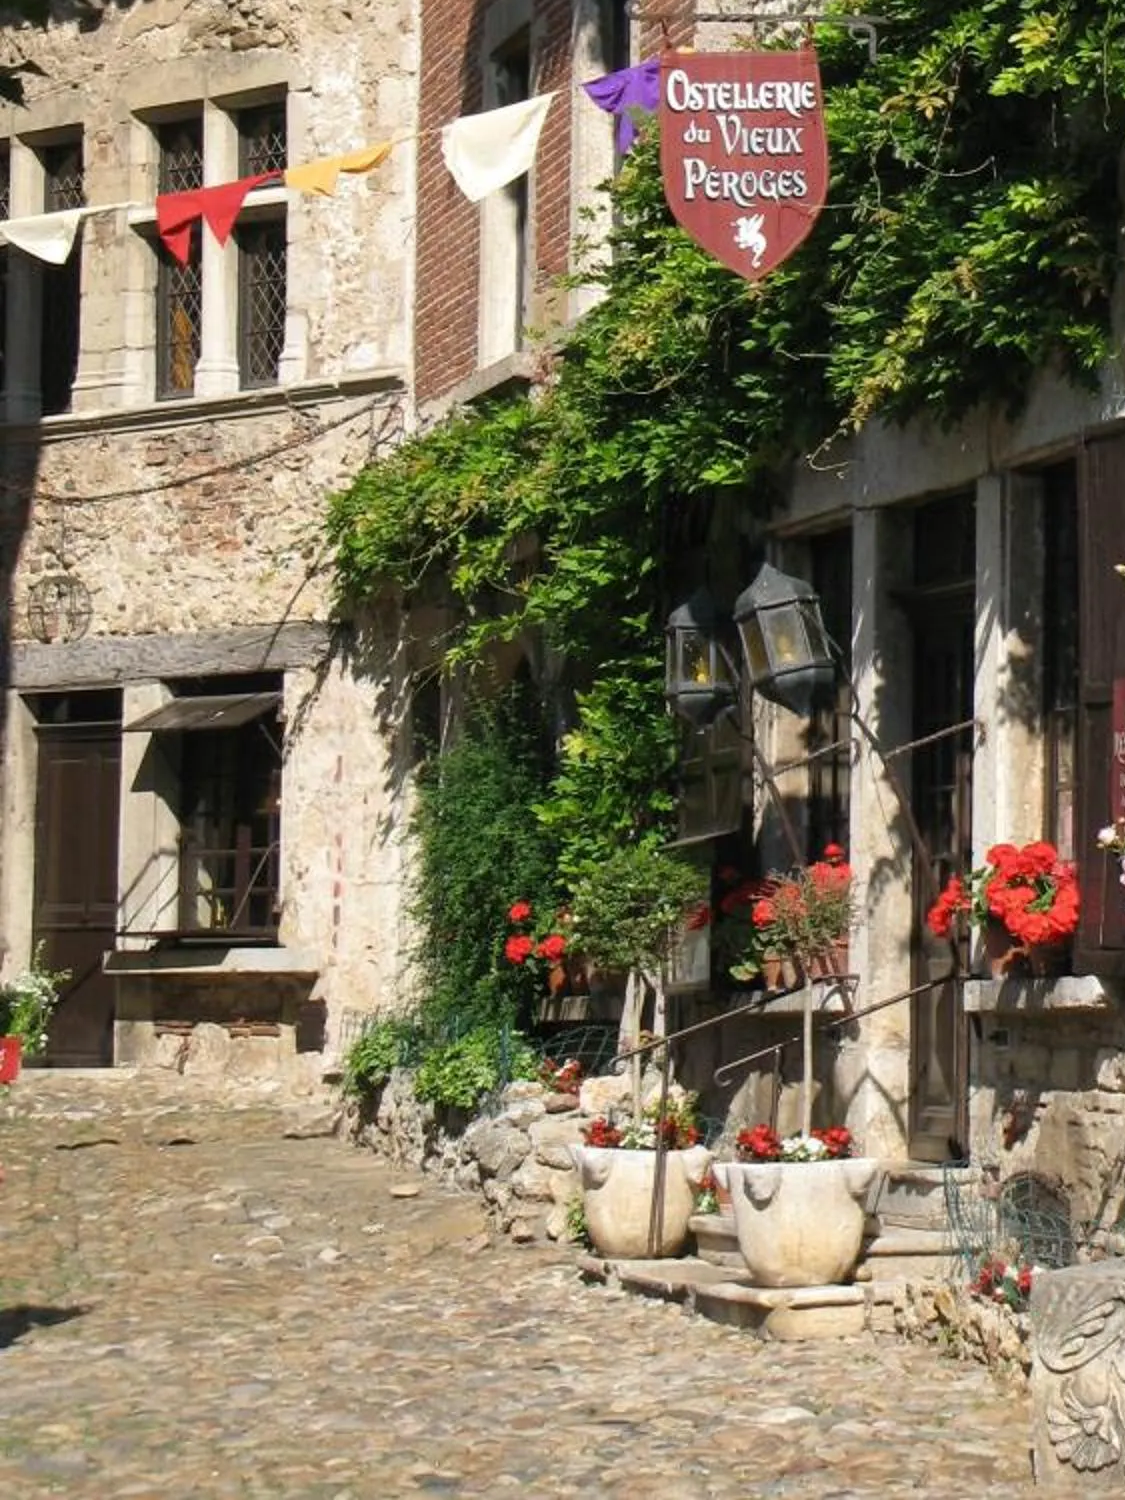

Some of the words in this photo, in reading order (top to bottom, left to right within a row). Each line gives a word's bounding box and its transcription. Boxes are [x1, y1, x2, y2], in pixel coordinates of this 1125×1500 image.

[667, 69, 816, 118] OSTELLERIE
[683, 120, 712, 144] du
[715, 115, 804, 155] VIEUX
[683, 158, 809, 208] PÉROGES
